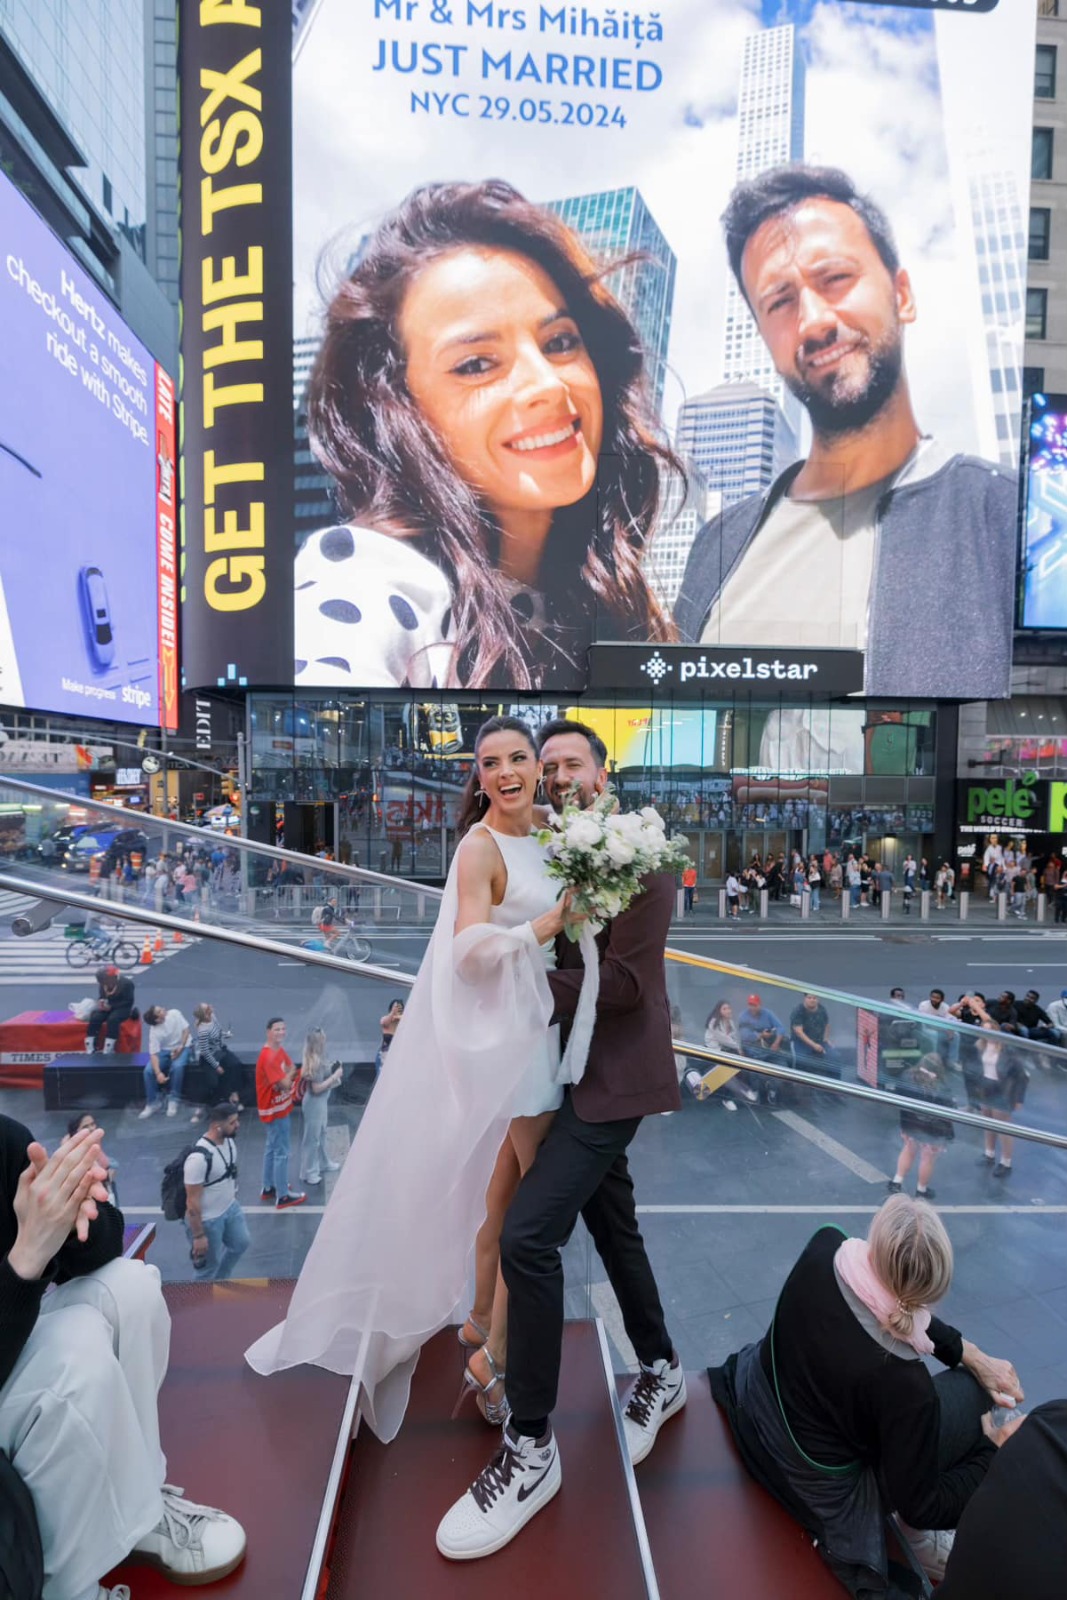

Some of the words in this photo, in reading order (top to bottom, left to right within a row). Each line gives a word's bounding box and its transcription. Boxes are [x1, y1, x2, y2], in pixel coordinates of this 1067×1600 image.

[374, 0, 418, 21] Mr
[430, 0, 453, 25] &
[466, 0, 527, 31] Mrs
[539, 3, 664, 49] Mihăiță
[372, 39, 468, 77] JUST
[481, 47, 663, 93] MARRIED
[410, 90, 470, 117] NYC
[478, 95, 628, 129] 29.05.2024
[199, 47, 264, 237] TSX
[6, 254, 88, 353] checkout
[89, 346, 99, 366] a
[101, 357, 148, 416] smooth
[60, 269, 107, 339] Hertz
[107, 330, 148, 387] makes
[201, 245, 264, 430] THE
[46, 331, 78, 376] ride
[81, 365, 111, 410] with
[159, 512, 174, 574] COME
[203, 449, 267, 613] GET
[680, 655, 818, 682] pixelstar
[121, 685, 152, 709] stripe
[968, 772, 1036, 823] pelé
[980, 815, 1025, 827] SOCCER
[11, 1052, 52, 1063] TIMES
